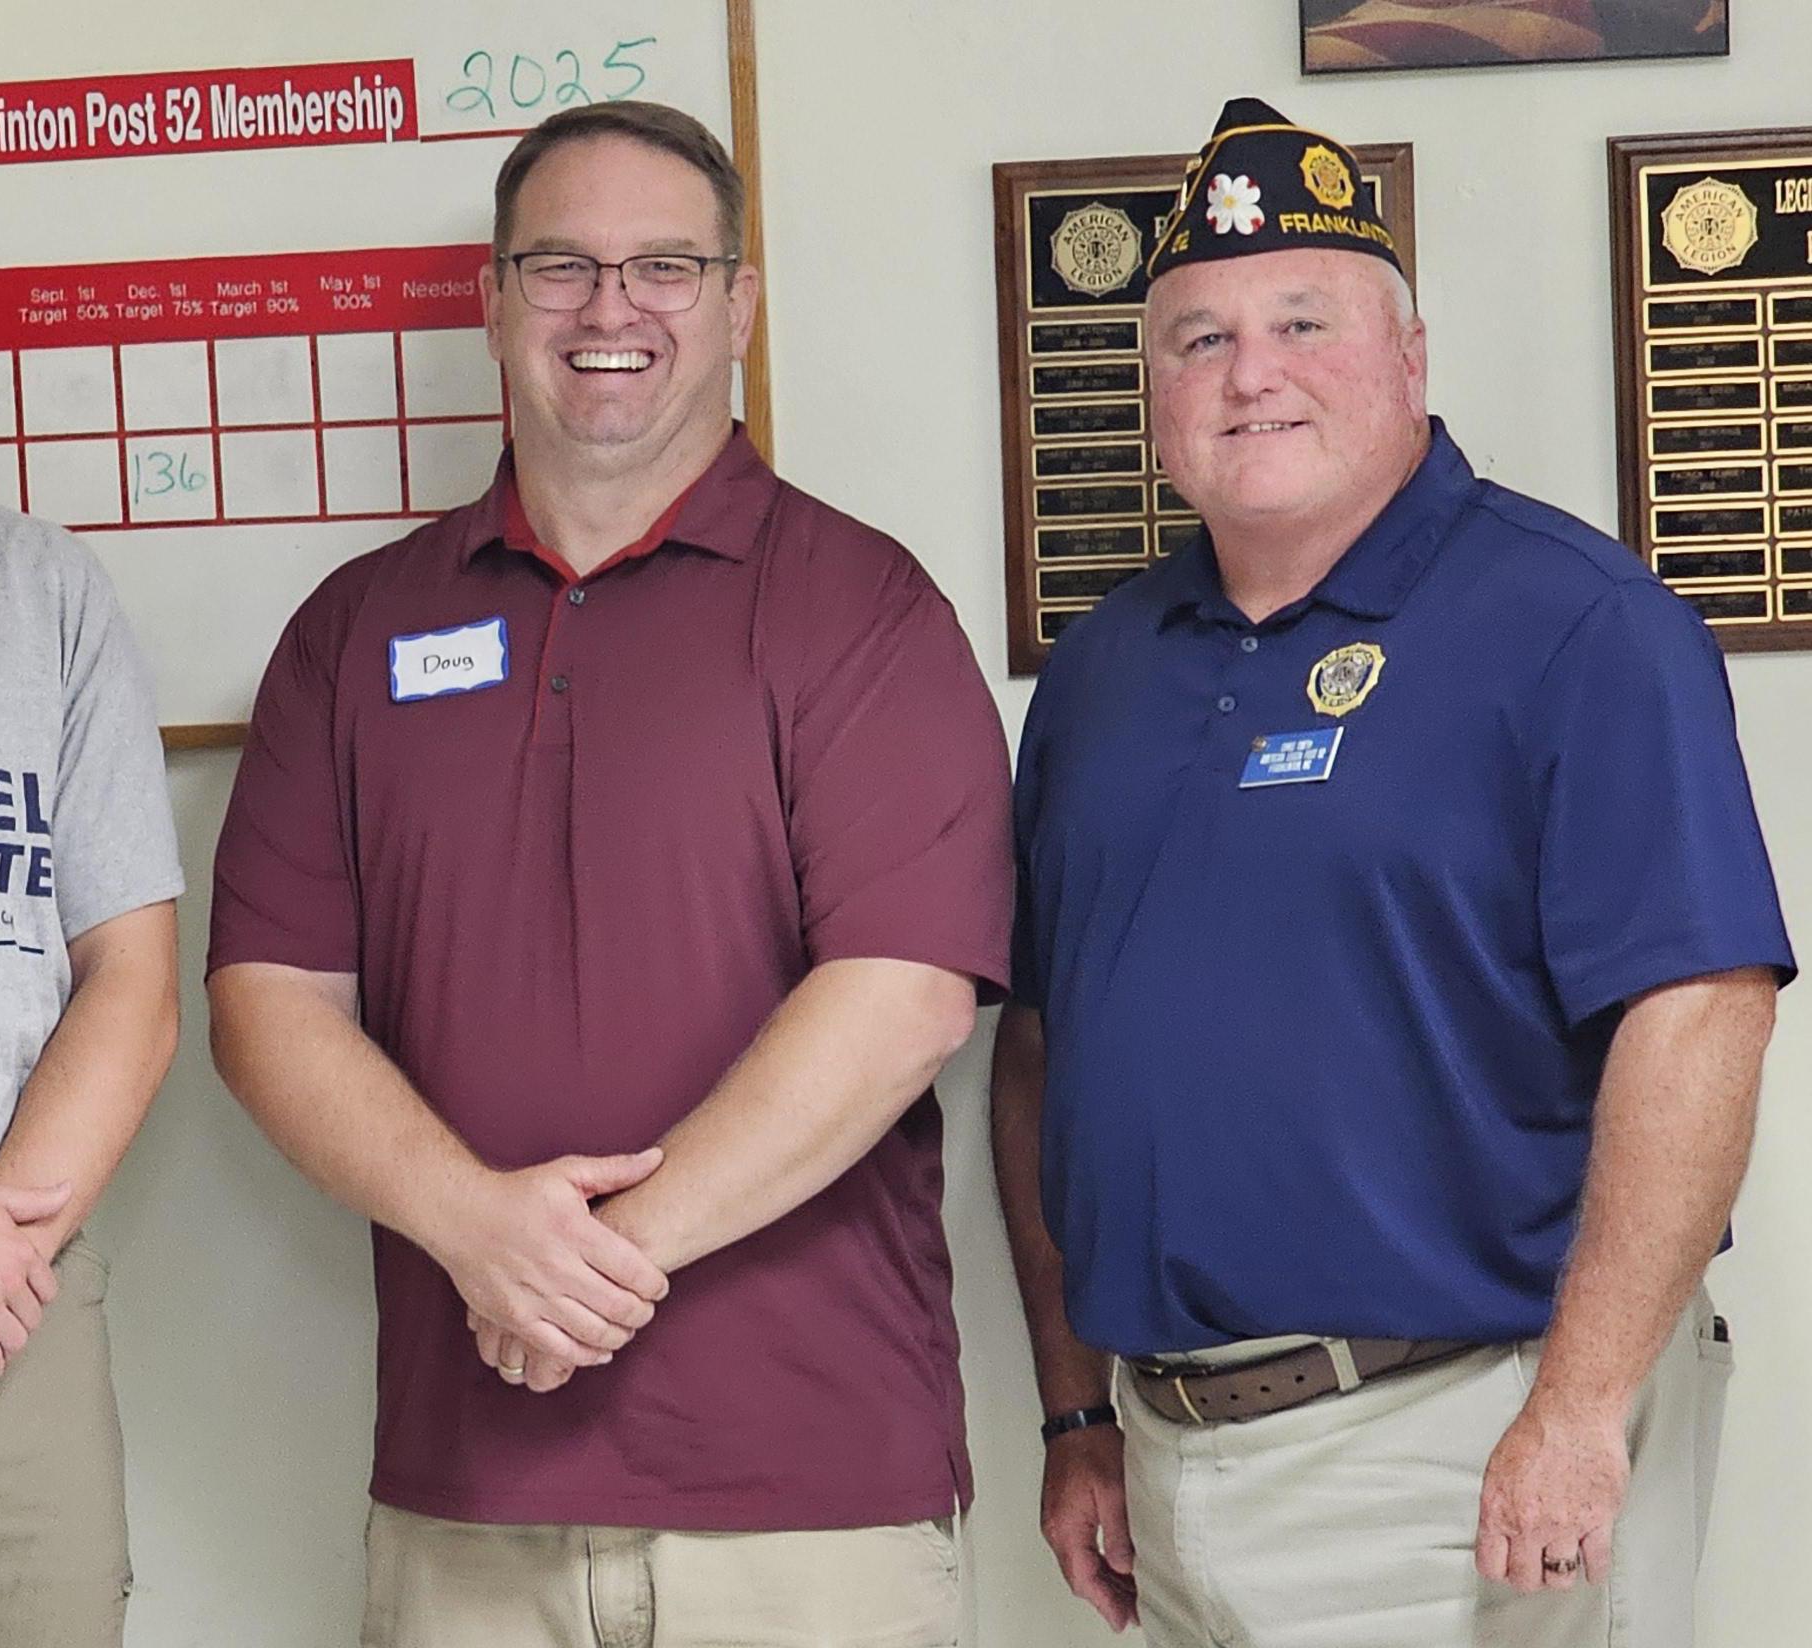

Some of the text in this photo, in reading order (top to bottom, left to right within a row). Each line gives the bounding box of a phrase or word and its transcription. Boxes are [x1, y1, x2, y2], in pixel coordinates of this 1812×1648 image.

[446, 37, 657, 119] 2025
[85, 91, 158, 147] Post
[165, 87, 203, 144] 52
[209, 75, 405, 144] Membership
[1674, 189, 1745, 223] AMERICAN
[1062, 213, 1130, 246] AMERICAN
[1683, 245, 1738, 263] LEGION
[320, 276, 354, 293] May
[1070, 267, 1124, 285] LEGION
[30, 287, 68, 304] Sept.
[127, 283, 161, 299] Dec.
[217, 281, 262, 298] March
[402, 278, 475, 299] Needed
[115, 300, 203, 321] Target 75%
[210, 297, 300, 318] Target 90%
[332, 293, 373, 310] 100%
[18, 304, 110, 326] Target 50%
[132, 452, 206, 505] 136
[423, 654, 475, 674] Doug
